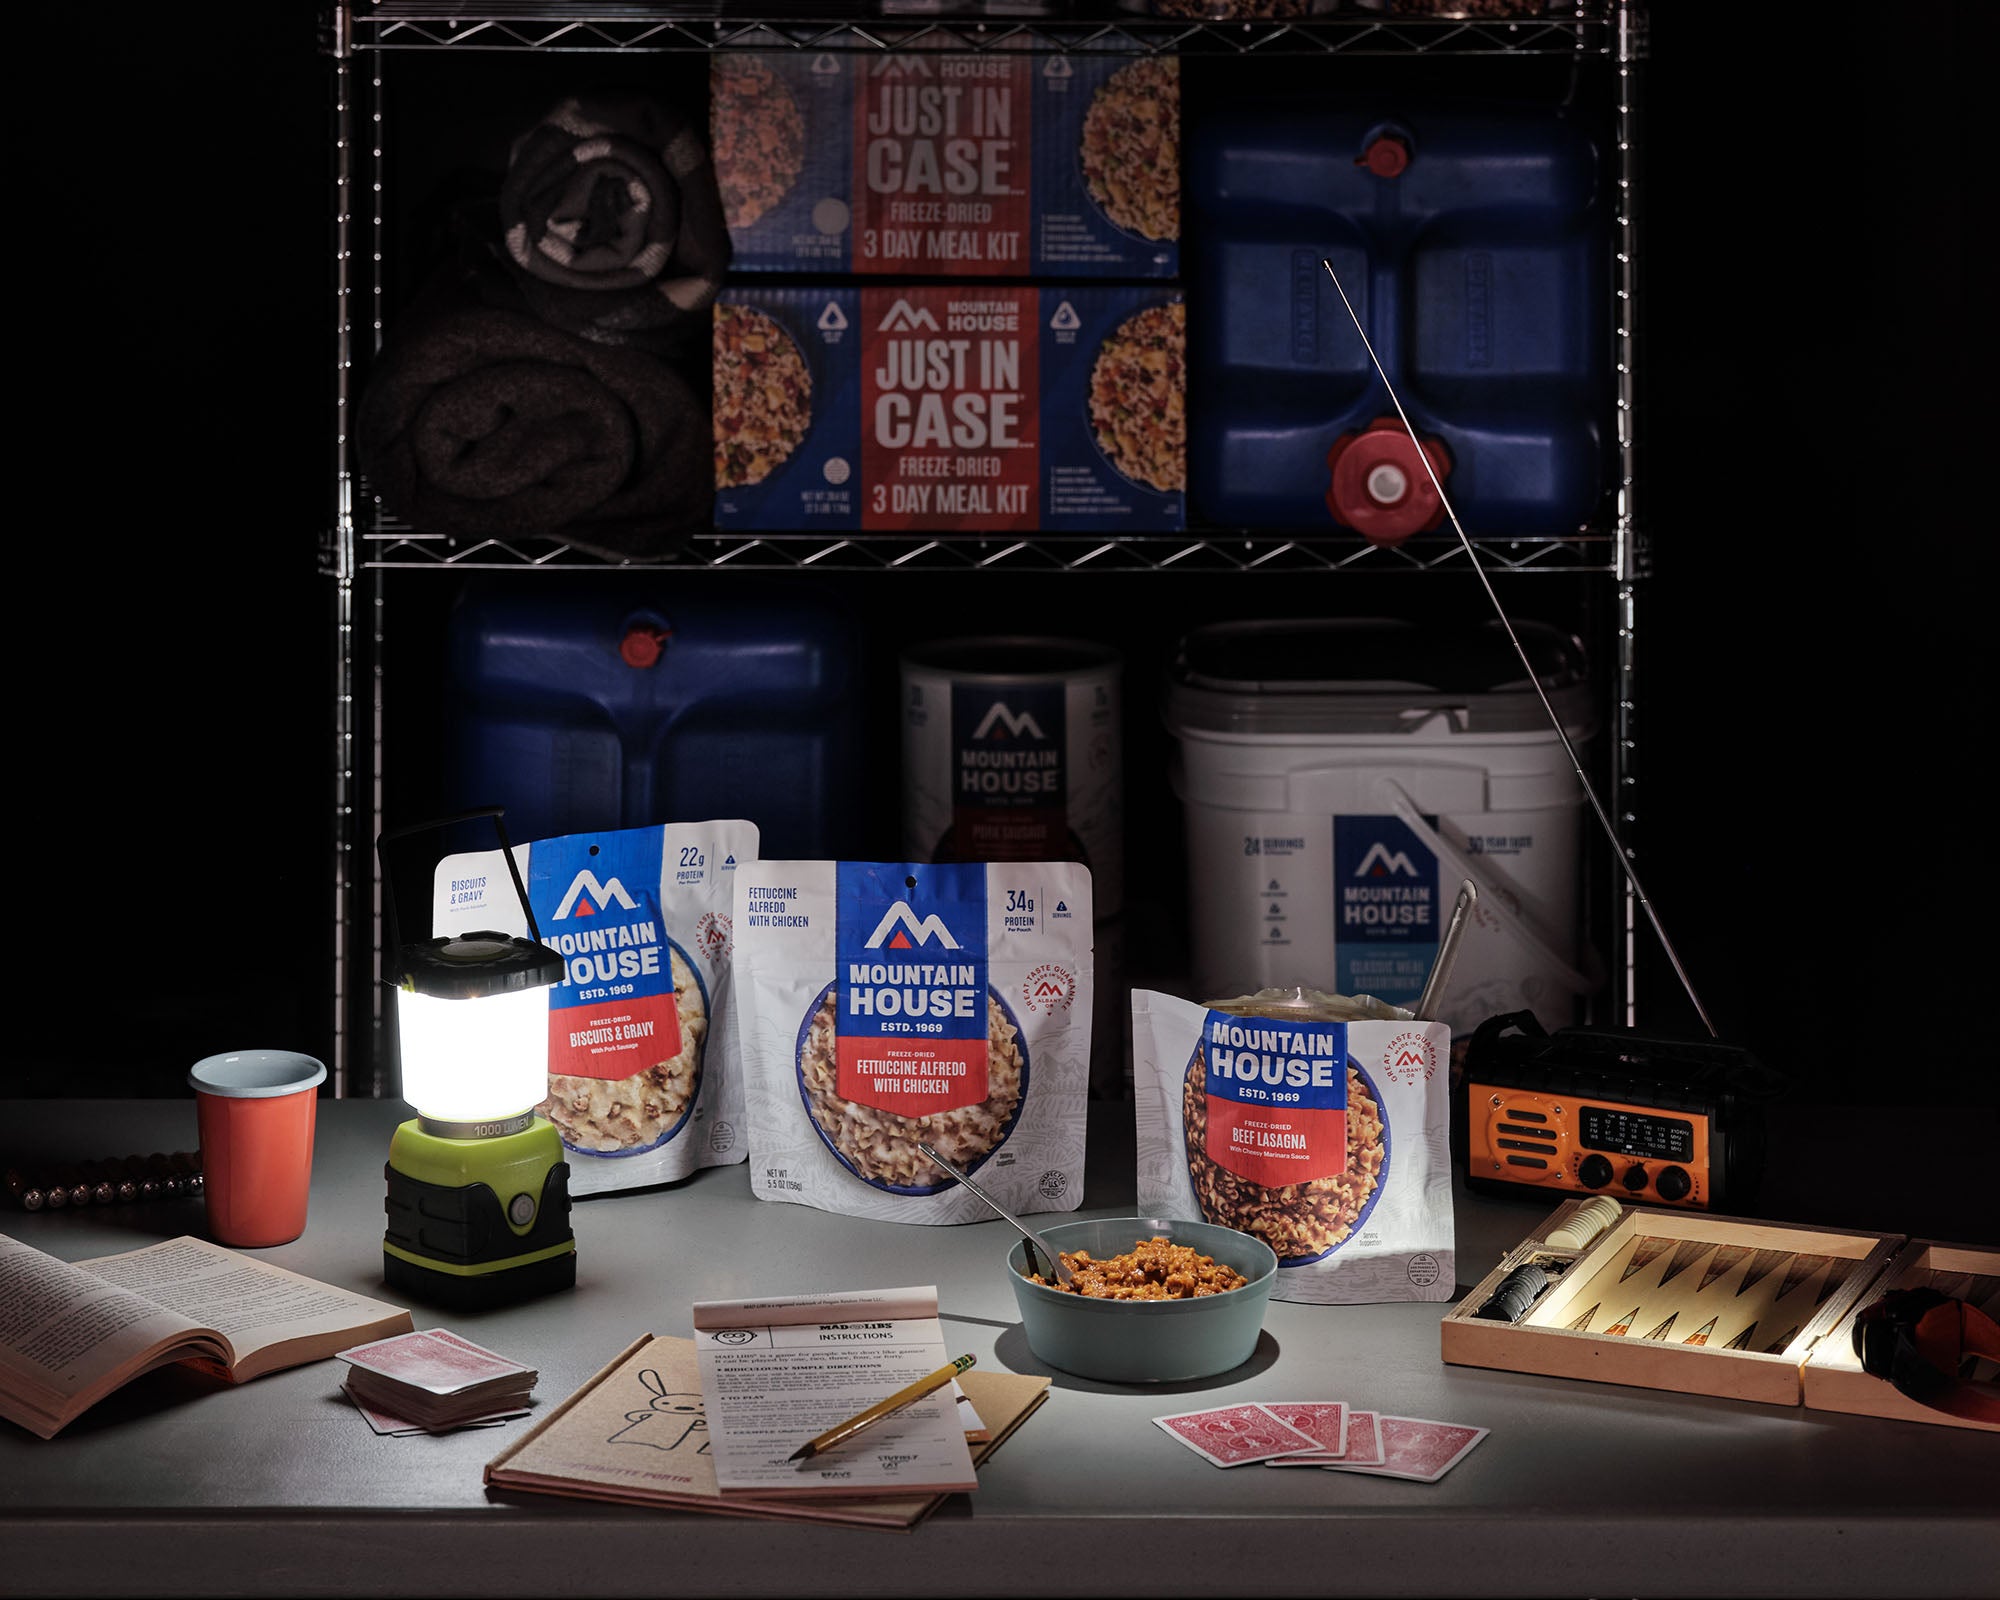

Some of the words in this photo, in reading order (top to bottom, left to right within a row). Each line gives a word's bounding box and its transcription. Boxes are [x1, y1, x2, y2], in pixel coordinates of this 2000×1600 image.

[940, 62, 1011, 79] HOUSE
[868, 86, 963, 137] JUST
[973, 86, 1011, 137] IN
[890, 202, 992, 224] FREEZE-DRIED
[865, 232, 876, 259] 3
[882, 231, 924, 260] DAY
[928, 231, 982, 260] MEAL
[988, 231, 1020, 260] KIT
[947, 301, 1019, 315] MOUNTAIN
[947, 316, 1019, 332] HOUSE
[876, 340, 971, 391] JUST
[981, 340, 1019, 391] IN
[899, 456, 1000, 477] FREEZE-DRIED
[873, 486, 886, 514] 3
[892, 485, 934, 515] DAY
[937, 485, 992, 515] MEAL
[998, 485, 1030, 515] KIT
[961, 750, 1057, 768] MOUNTAIN
[961, 771, 1058, 793] HOUSE
[680, 847, 704, 867] 22g
[676, 870, 704, 880] PROTEIN
[451, 876, 487, 892] BISCUITS
[450, 894, 458, 905] &
[458, 890, 484, 904] GRAVY
[749, 888, 797, 900] FETTUCCINE
[1006, 890, 1034, 913] 34g
[1344, 886, 1430, 902] MOUNTAIN
[749, 902, 785, 914] ALFREDO
[1344, 904, 1431, 925] HOUSE
[749, 915, 771, 927] WITH
[772, 916, 809, 928] CHICKEN
[1005, 916, 1035, 927] PROTEIN
[850, 964, 975, 985] MOUNTAIN
[1026, 964, 1051, 981] TASTE
[579, 989, 608, 1000] ESTD.
[609, 984, 634, 996] 1969
[1023, 983, 1037, 1012] GREAT
[850, 987, 976, 1017] HOUSE
[590, 1015, 632, 1027] FREEZE-DRIED
[881, 1022, 914, 1032] ESTD.
[916, 1023, 943, 1033] 1969
[569, 1028, 614, 1048] BISCUITS
[615, 1027, 623, 1041] &
[623, 1021, 654, 1039] GRAVY
[1212, 1021, 1334, 1056] MOUNTAIN
[591, 1046, 603, 1055] With
[604, 1045, 617, 1053] Pork
[617, 1042, 639, 1052] Sausage
[1387, 1032, 1412, 1051] TASTE
[1415, 1033, 1437, 1081] GUARANTEE
[857, 1060, 918, 1075] FETTUCCINE
[920, 1061, 966, 1076] ALFREDO
[1212, 1048, 1335, 1088] HOUSE
[1384, 1053, 1398, 1082] GREAT
[873, 1078, 901, 1093] WITH
[903, 1079, 949, 1094] CHICKEN
[1239, 1087, 1269, 1101] ESTD.
[1271, 1091, 1300, 1102] 1969
[474, 1124, 501, 1137] 1000
[1244, 1120, 1292, 1131] FREEZE-DRIED
[1232, 1128, 1255, 1146] BEEF
[1257, 1130, 1307, 1150] LASAGNA
[1229, 1145, 1241, 1153] With
[1242, 1147, 1262, 1157] Cheesy
[1263, 1150, 1290, 1159] Marinara
[819, 1323, 849, 1331] MAD
[864, 1322, 892, 1330] LIBS
[819, 1332, 893, 1341] INSTRUCTIONS
